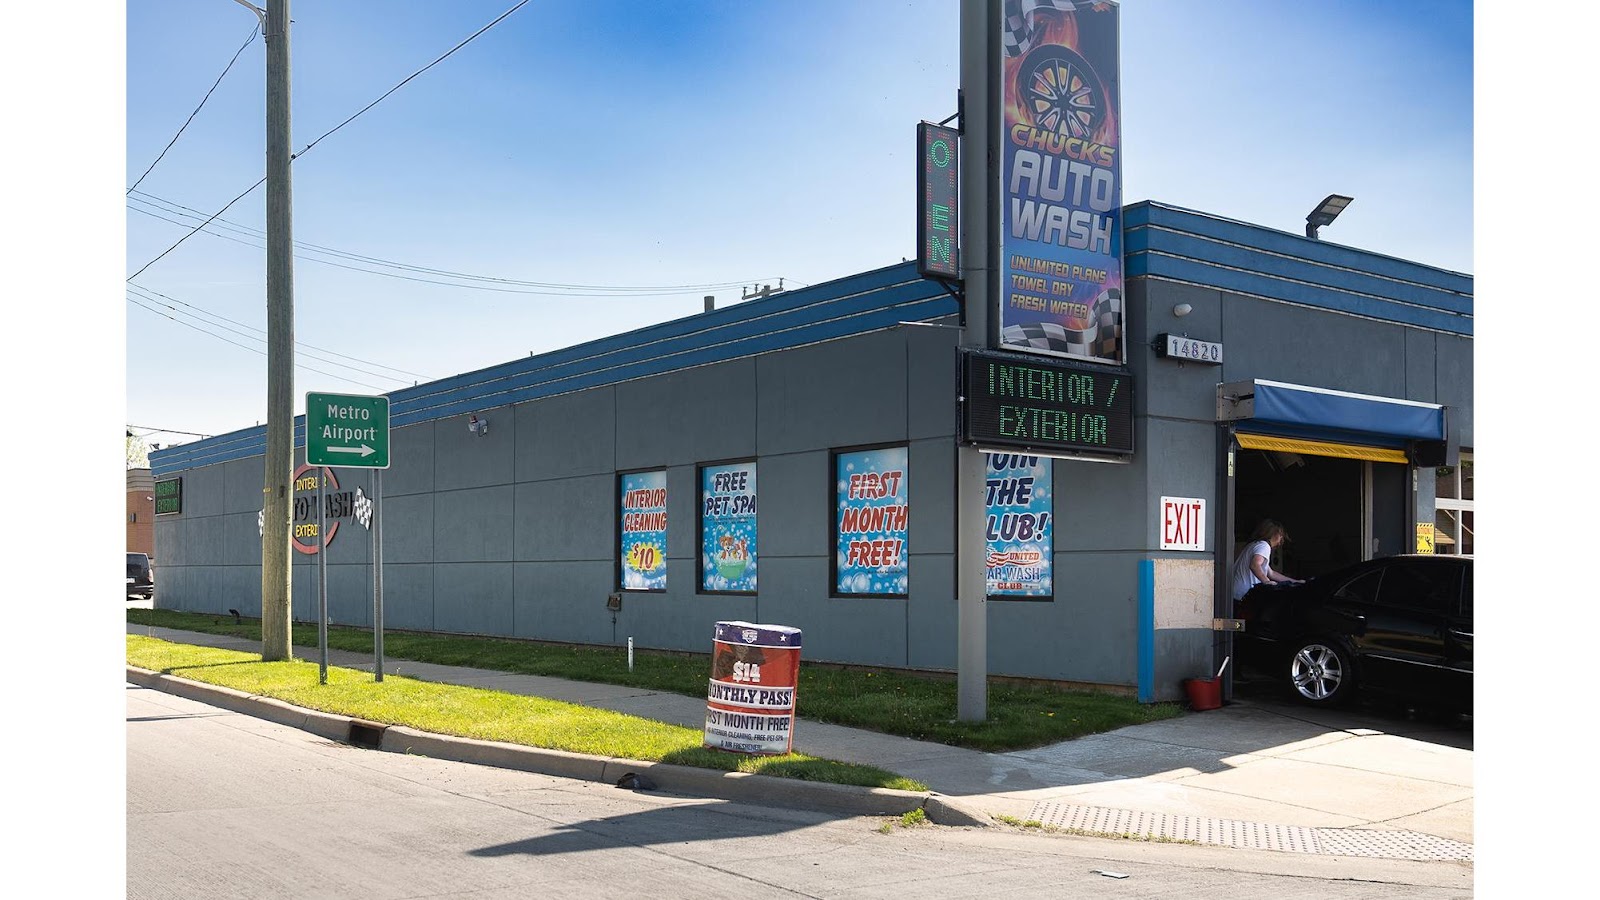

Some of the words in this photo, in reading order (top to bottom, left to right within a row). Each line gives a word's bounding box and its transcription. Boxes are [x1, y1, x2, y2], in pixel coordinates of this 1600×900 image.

[1010, 123, 1115, 168] CHUCKS
[1010, 149, 1114, 212] AUTO
[930, 140, 950, 263] OEN
[1011, 197, 1113, 255] WASH
[1010, 255, 1069, 278] UNLIMITED
[1072, 265, 1107, 284] PLANS
[1011, 274, 1049, 294] TOWEL
[1051, 281, 1074, 297] DRY
[1010, 294, 1047, 312] FRESH
[1050, 299, 1088, 320] WATER
[1172, 339, 1219, 361] 14820
[989, 363, 1094, 406] INTERIOR
[328, 404, 370, 420] Metro
[322, 423, 375, 443] Airport
[1000, 405, 1107, 445] EXTERIOR
[714, 471, 748, 493] FREE
[848, 471, 902, 499] FIRST
[986, 477, 1034, 507] THE
[625, 488, 667, 509] INTERIOR
[705, 496, 730, 516] PET
[731, 494, 756, 515] SPA
[295, 524, 319, 538] EXTERI
[624, 512, 667, 532] CLEANING
[841, 505, 908, 534] MONTH
[986, 512, 1049, 542] LUB!
[1165, 502, 1201, 545] EXIT
[633, 543, 655, 569] $10
[848, 540, 902, 568] FREE!
[1009, 552, 1040, 561] UNITED
[987, 568, 1002, 580] AR
[1005, 567, 1040, 581] WASH
[997, 582, 1023, 590] CLUB
[733, 660, 760, 683] $14
[759, 689, 792, 706] PASS!
[724, 712, 764, 731] MONTH
[767, 716, 790, 731] FREE
[753, 734, 766, 742] FREE
